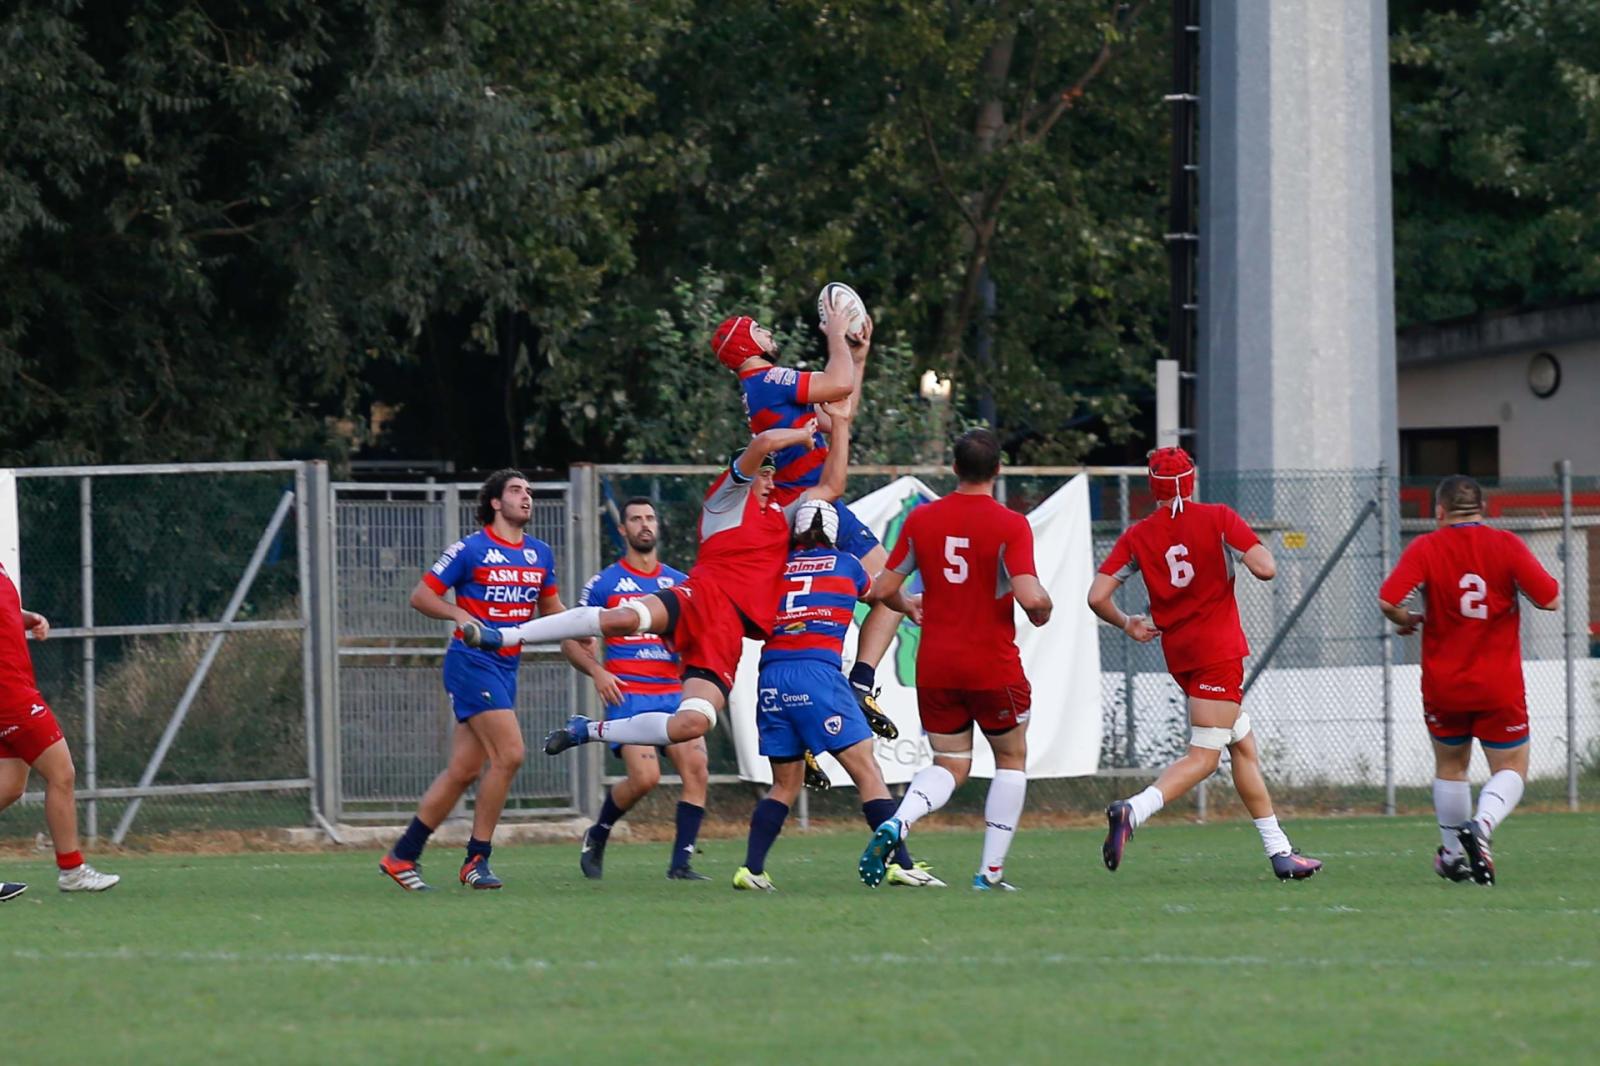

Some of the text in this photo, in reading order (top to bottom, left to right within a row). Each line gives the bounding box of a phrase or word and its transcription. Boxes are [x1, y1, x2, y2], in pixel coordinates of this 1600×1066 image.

[786, 560, 833, 573] olmec
[943, 535, 970, 584] 5
[1165, 543, 1195, 588] 6
[487, 569, 542, 583] ASM SET
[484, 585, 540, 602] FEMI-C
[786, 576, 812, 613] 2
[1458, 573, 1488, 620] 2
[781, 693, 810, 703] Group
